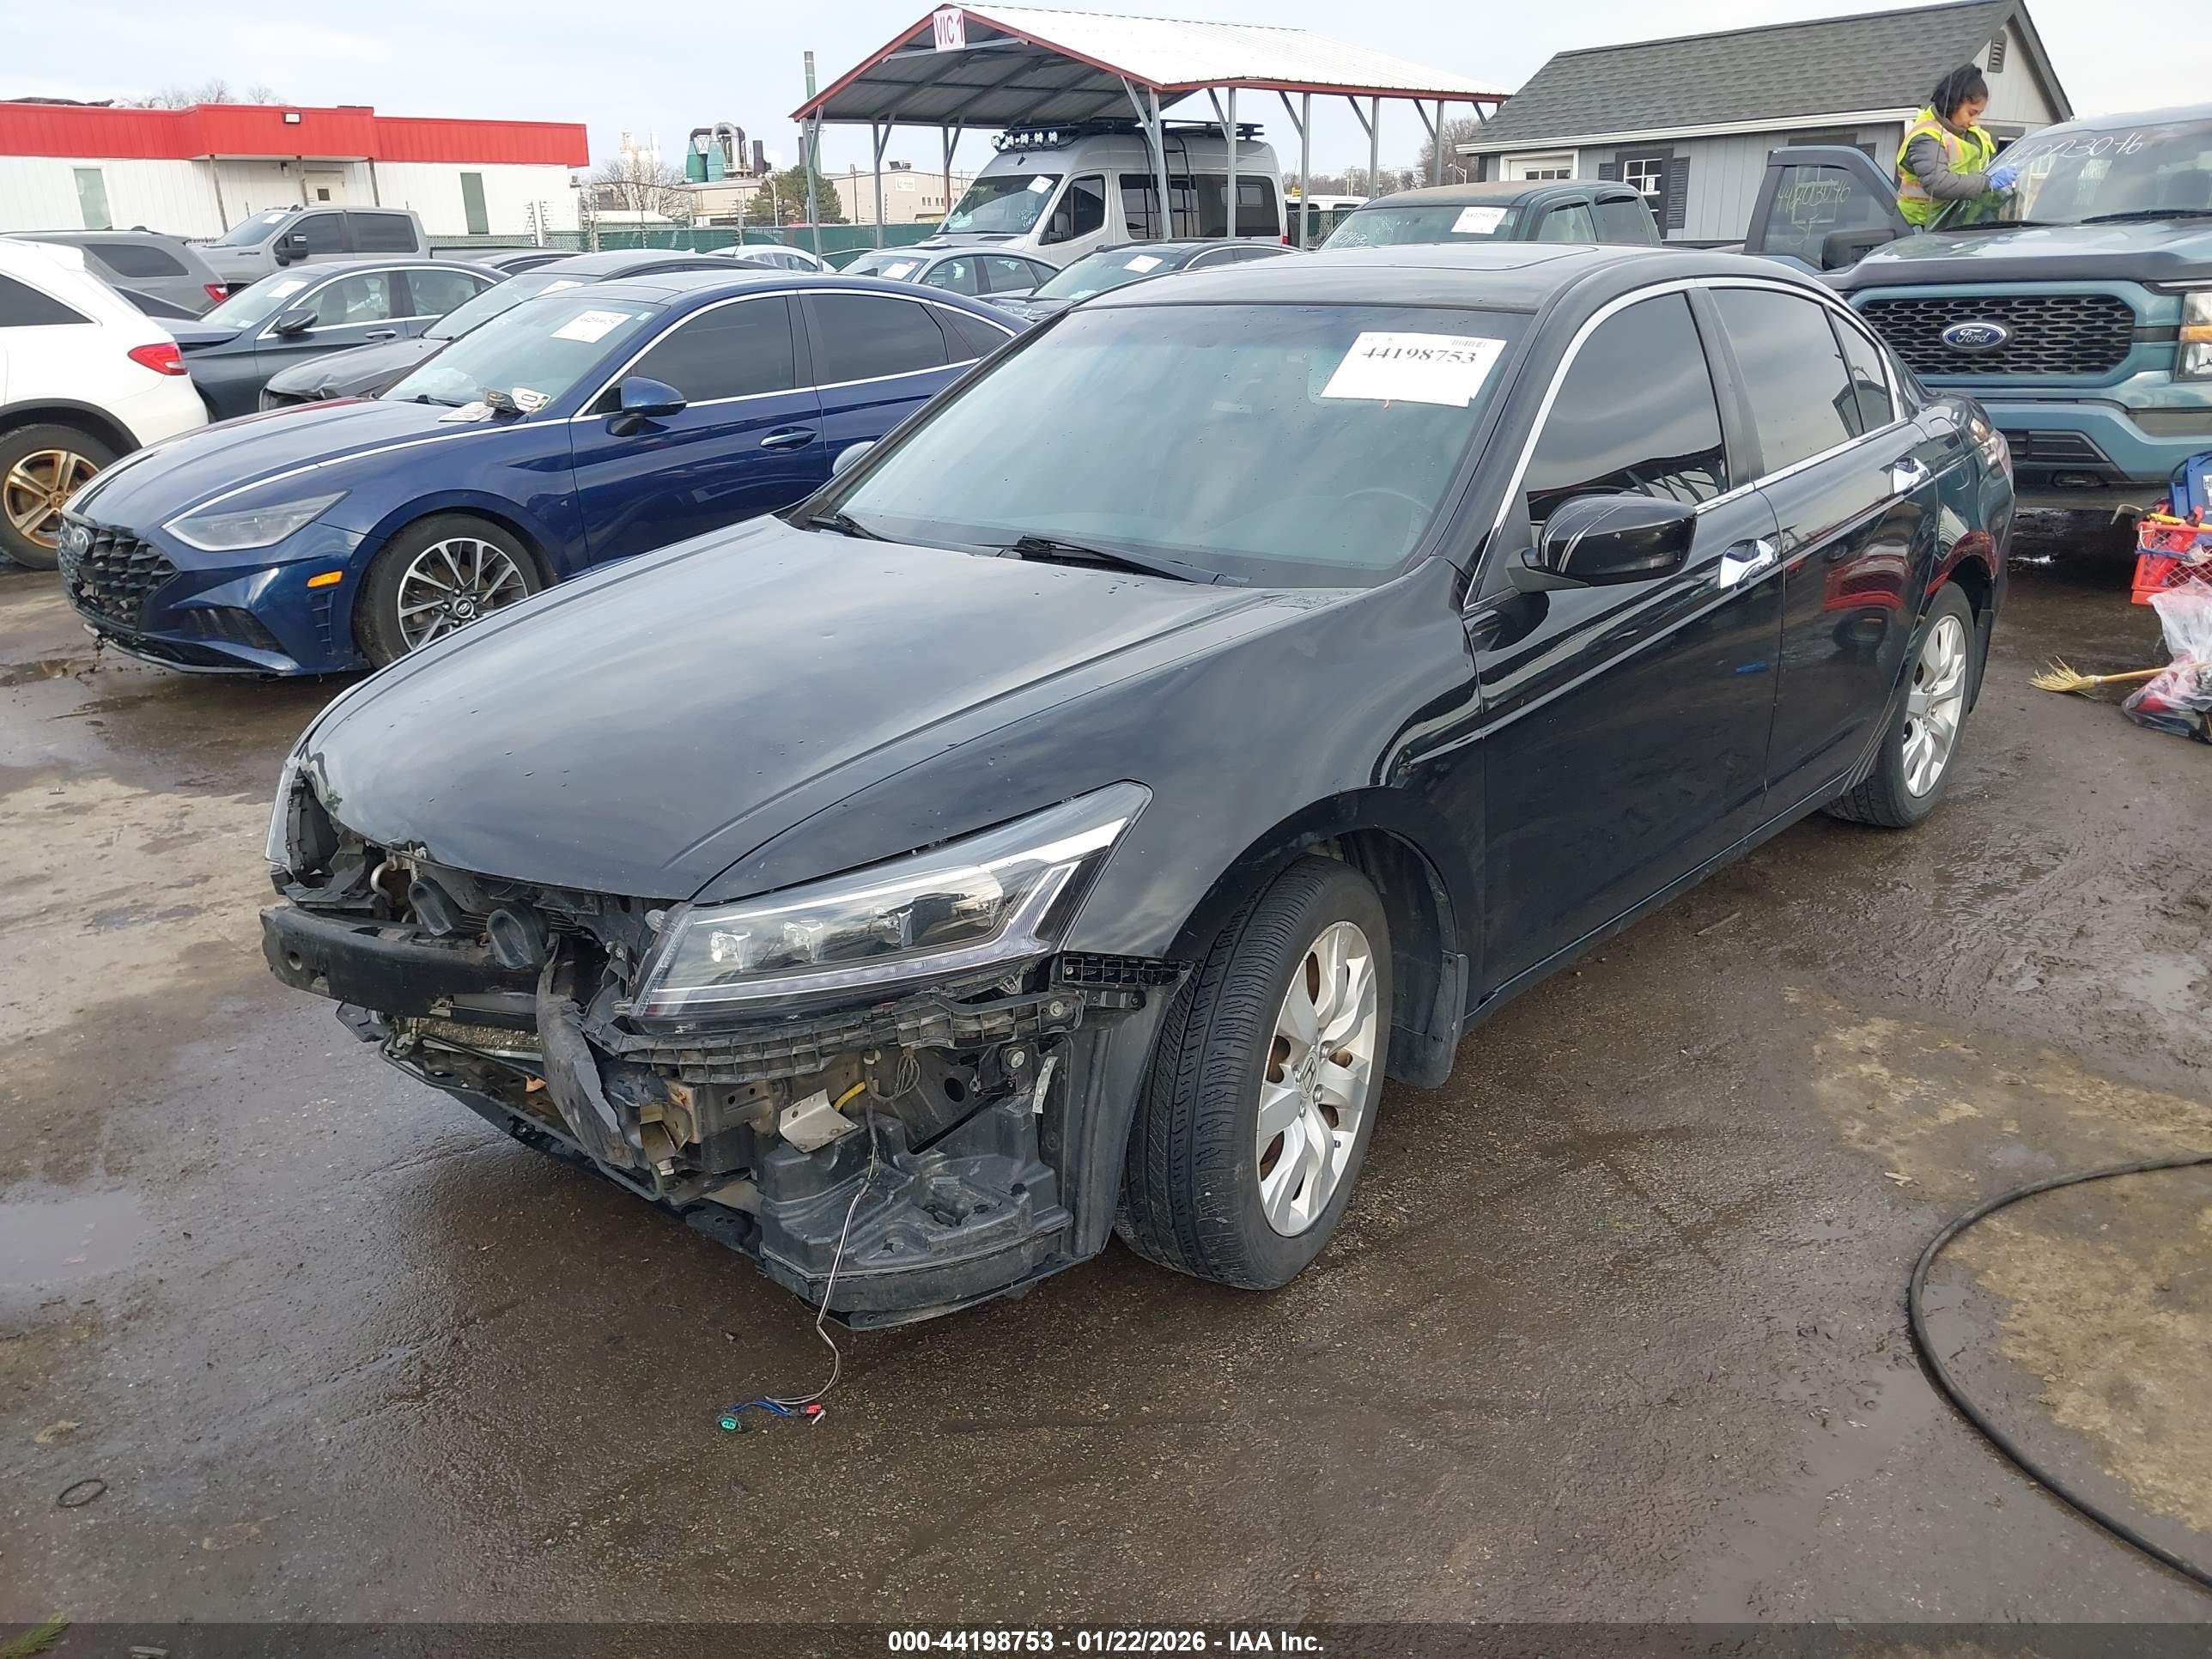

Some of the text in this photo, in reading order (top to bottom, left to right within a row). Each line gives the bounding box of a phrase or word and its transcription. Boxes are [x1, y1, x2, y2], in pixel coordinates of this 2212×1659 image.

[934, 13, 963, 46] VIC 1
[1955, 328, 1991, 343] Ford
[1362, 346, 1478, 364] 44198753
